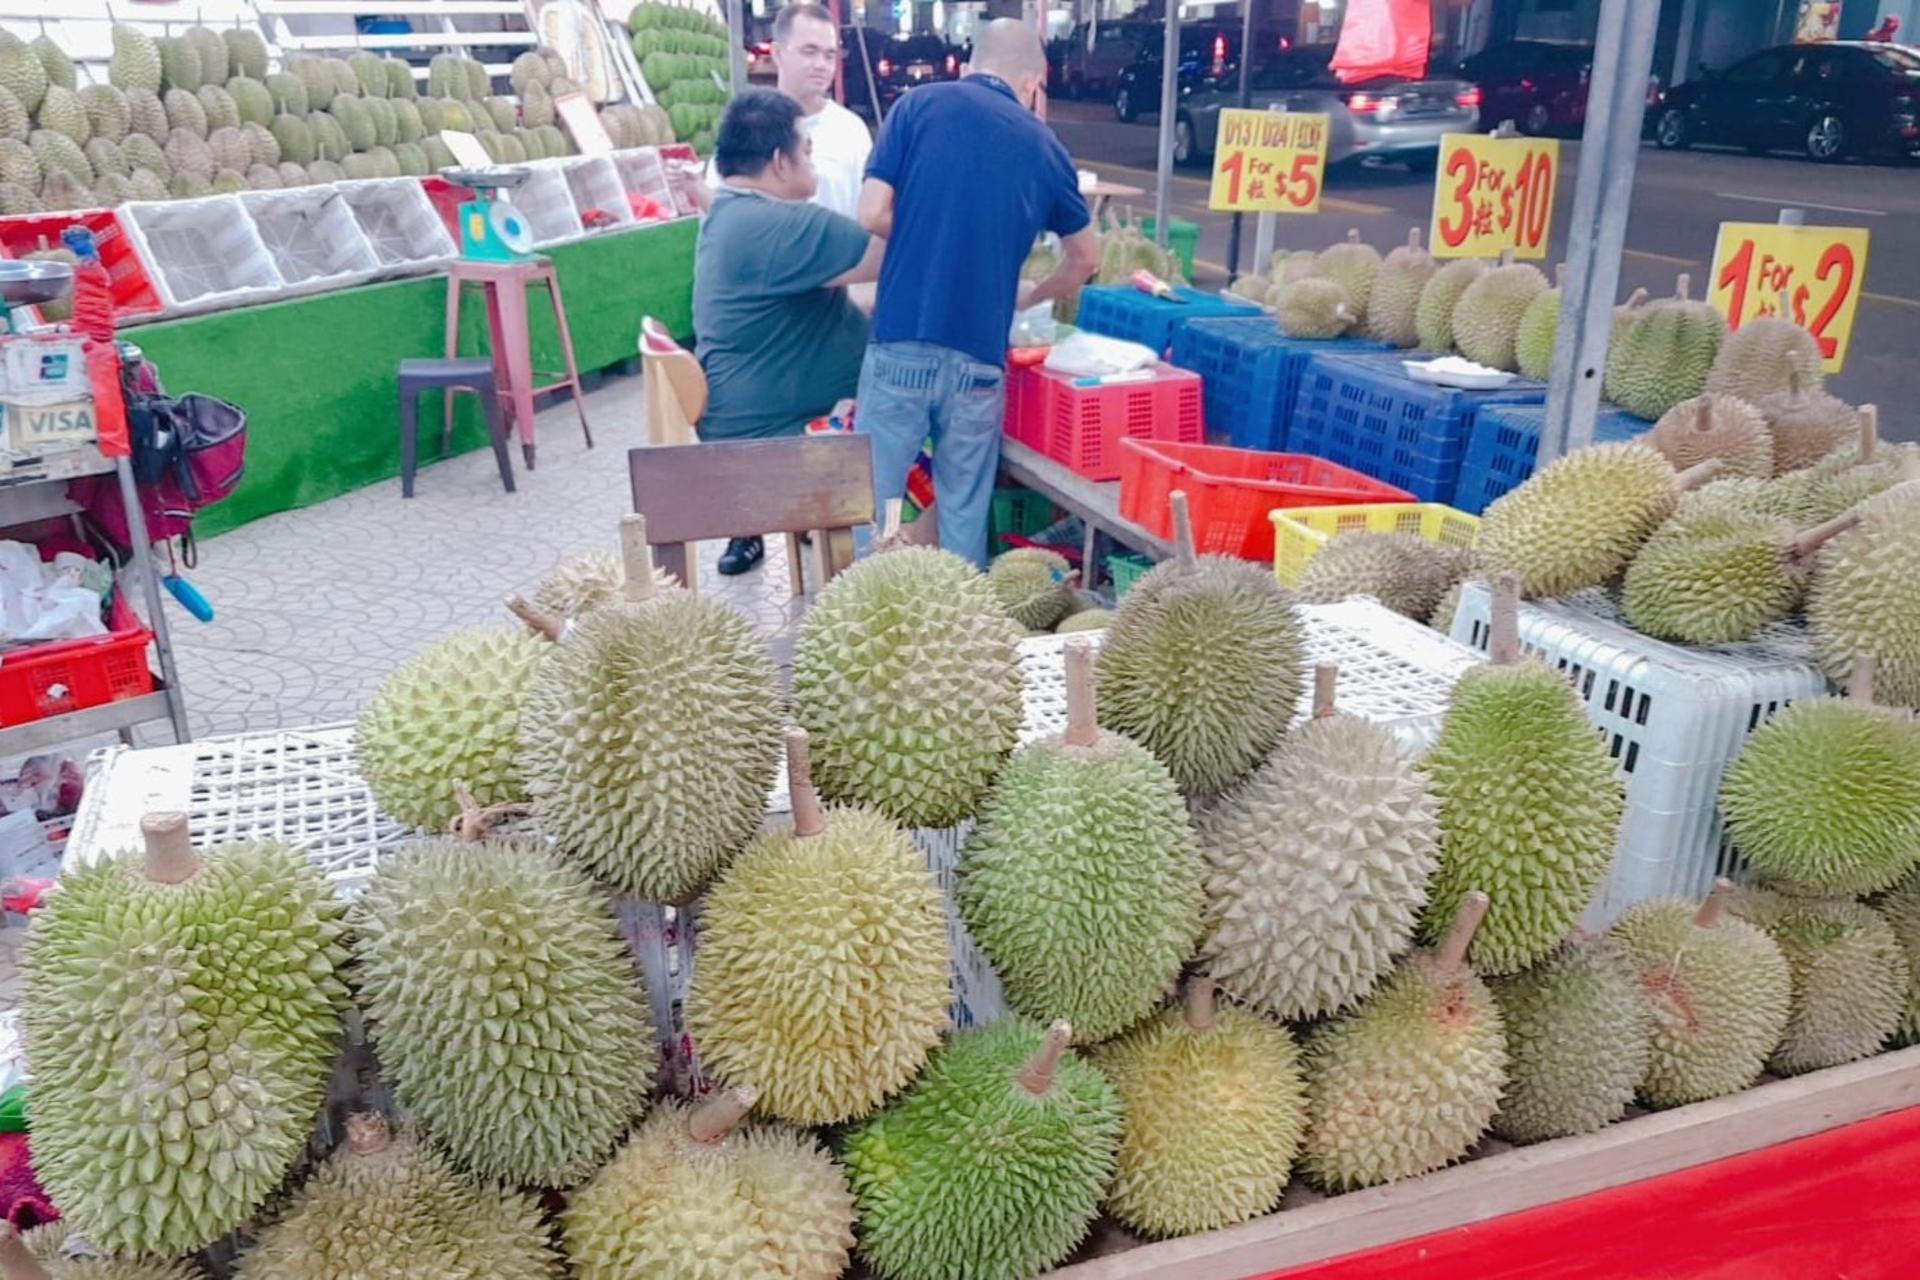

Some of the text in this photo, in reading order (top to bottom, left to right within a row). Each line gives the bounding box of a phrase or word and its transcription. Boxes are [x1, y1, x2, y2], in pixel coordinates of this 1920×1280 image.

[1221, 151, 1319, 208] 1 For $5
[1438, 147, 1552, 248] 3 For $10
[1718, 239, 1755, 333] 1
[1757, 254, 1794, 292] For
[28, 411, 92, 433] VISA
